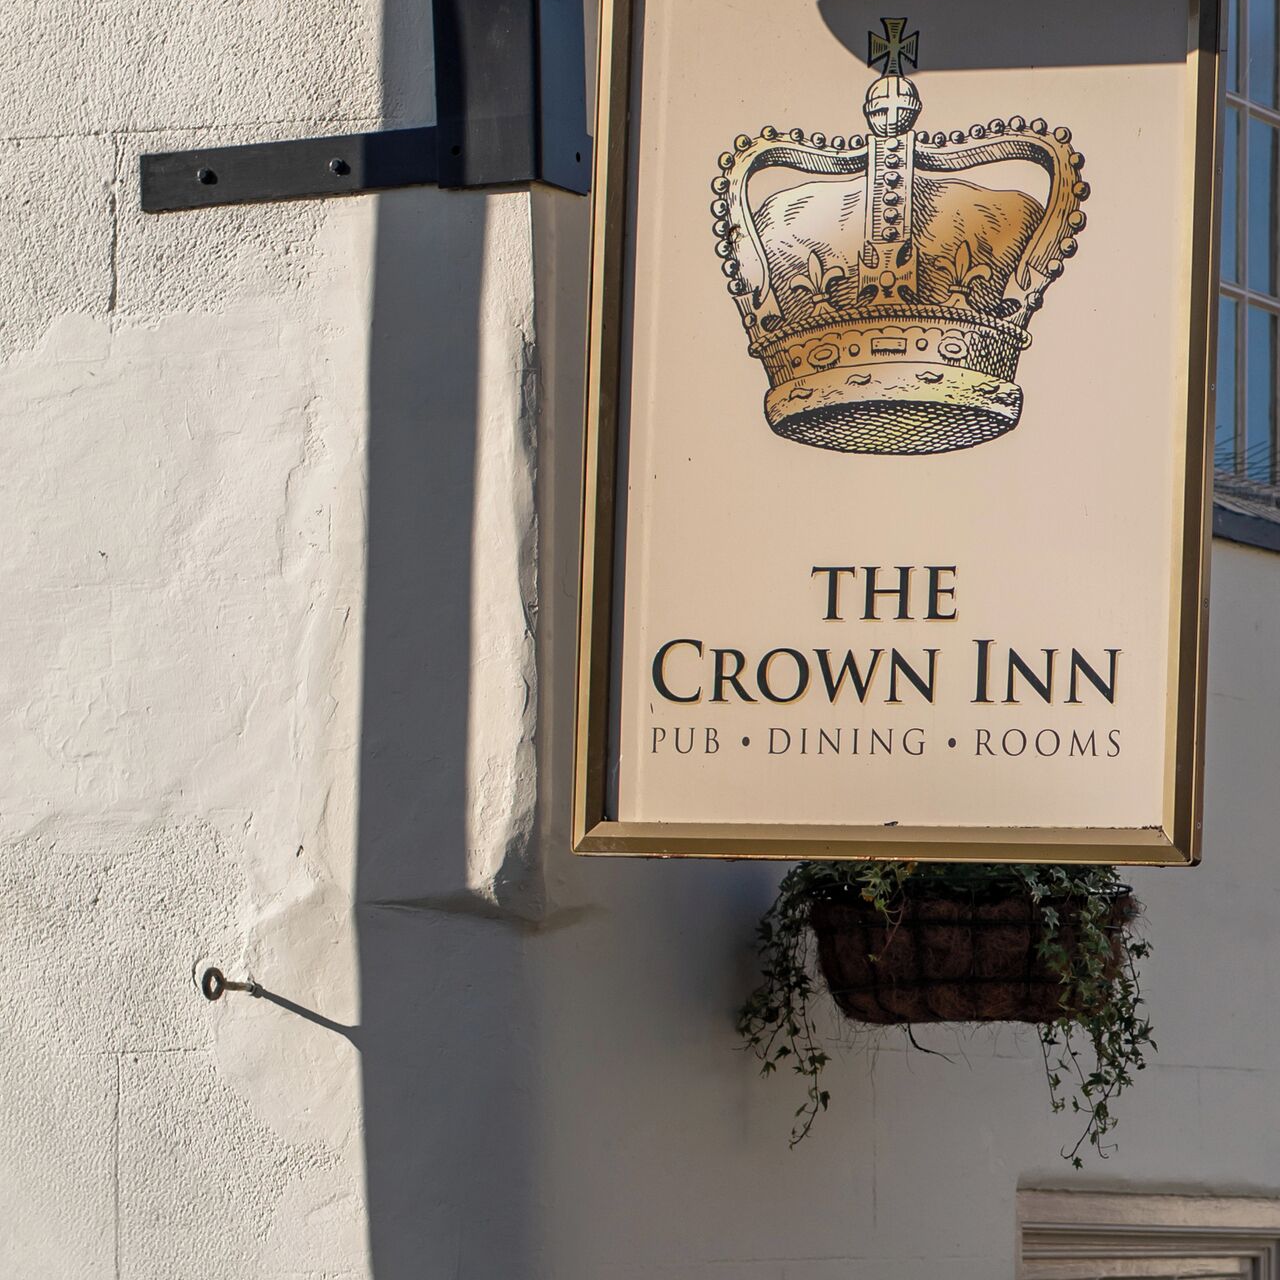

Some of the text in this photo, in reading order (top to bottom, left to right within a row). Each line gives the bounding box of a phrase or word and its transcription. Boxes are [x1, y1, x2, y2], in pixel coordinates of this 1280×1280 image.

[811, 565, 959, 622] THE
[651, 638, 1123, 705] CROWN INN
[650, 727, 1122, 758] PUB DINING ROOMS
